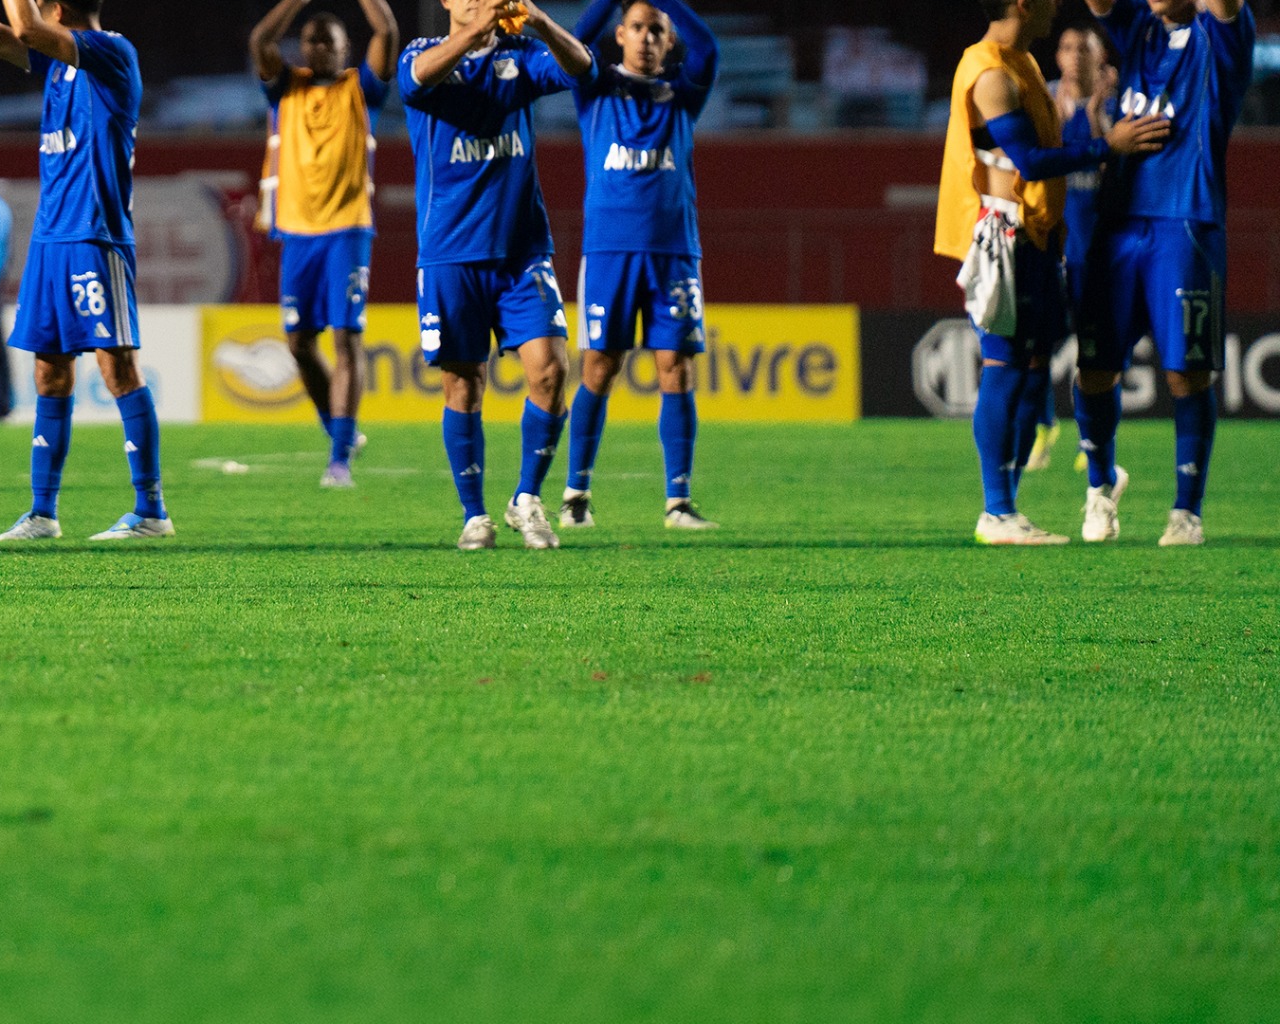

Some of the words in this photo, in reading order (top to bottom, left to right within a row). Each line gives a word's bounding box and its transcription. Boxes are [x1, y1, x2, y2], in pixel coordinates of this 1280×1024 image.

[450, 130, 524, 164] ANDINA
[72, 280, 107, 317] 28
[670, 284, 702, 320] 33
[1182, 298, 1209, 336] 17
[692, 326, 838, 396] ivre
